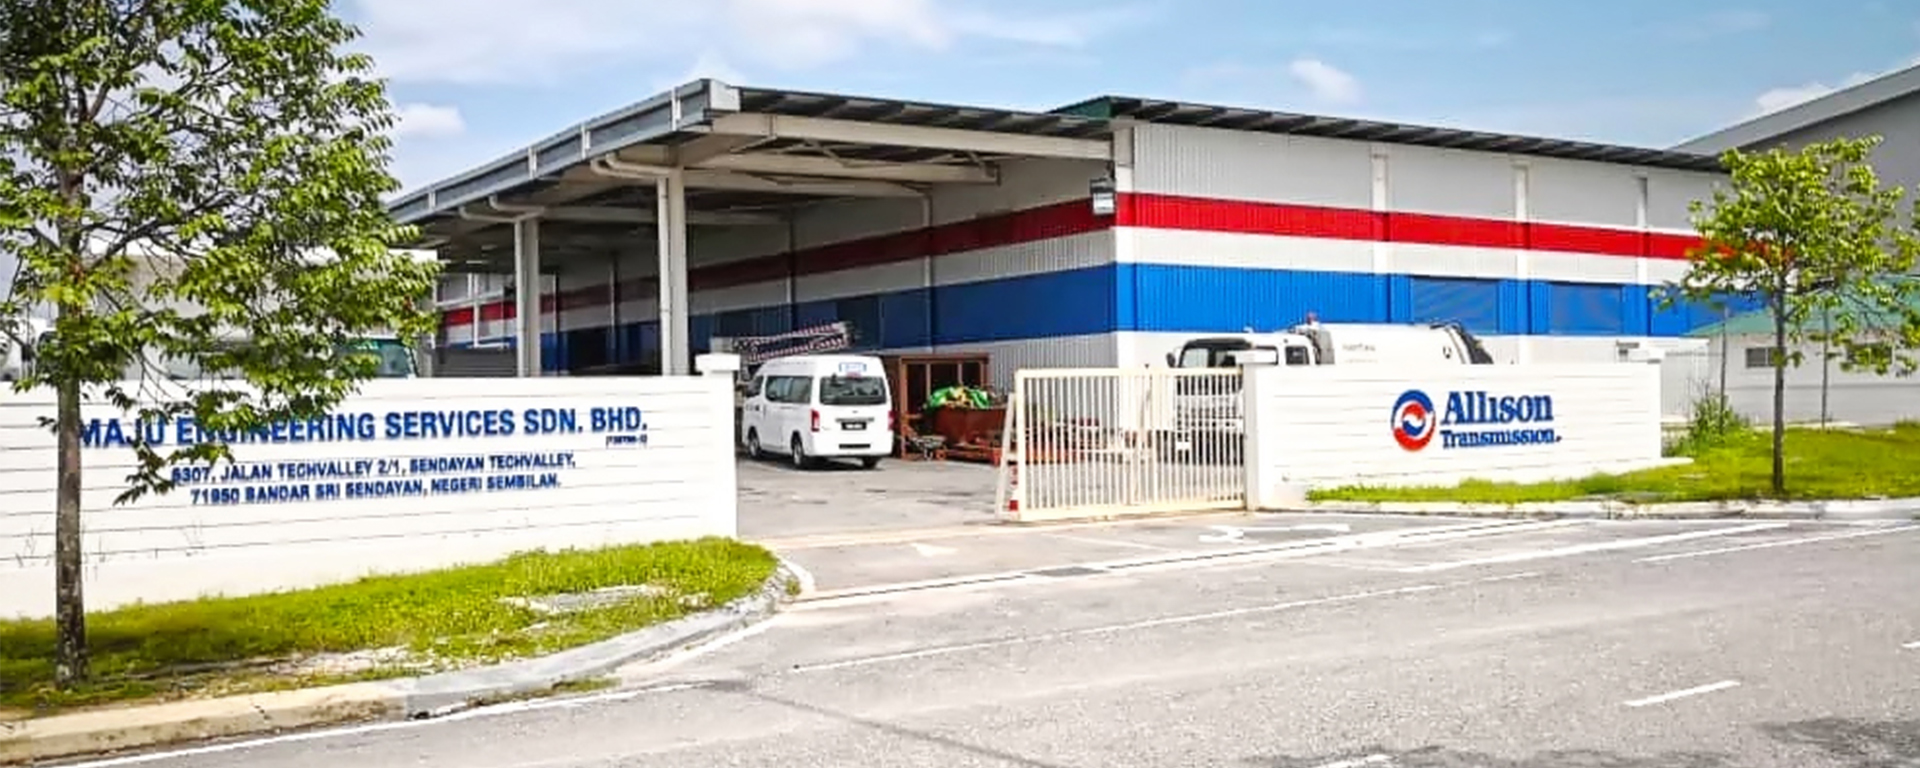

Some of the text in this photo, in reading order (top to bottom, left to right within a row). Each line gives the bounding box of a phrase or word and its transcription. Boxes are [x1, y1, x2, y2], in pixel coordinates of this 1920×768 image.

[1440, 391, 1554, 425] Allison
[79, 417, 166, 447] MAJU
[385, 409, 515, 438] SERVICES
[524, 407, 583, 435] SDN.
[591, 406, 648, 432] BHD.
[220, 465, 272, 482] JALAN
[277, 459, 373, 479] TECHVALLEY
[378, 459, 407, 477] 2/1,
[409, 456, 485, 474] SENDAYAN
[489, 453, 576, 470] TECHVALLEY,
[190, 473, 562, 505] 71950 BANDAR SRI SENDAYAN, NEGERI SEMBILAN.
